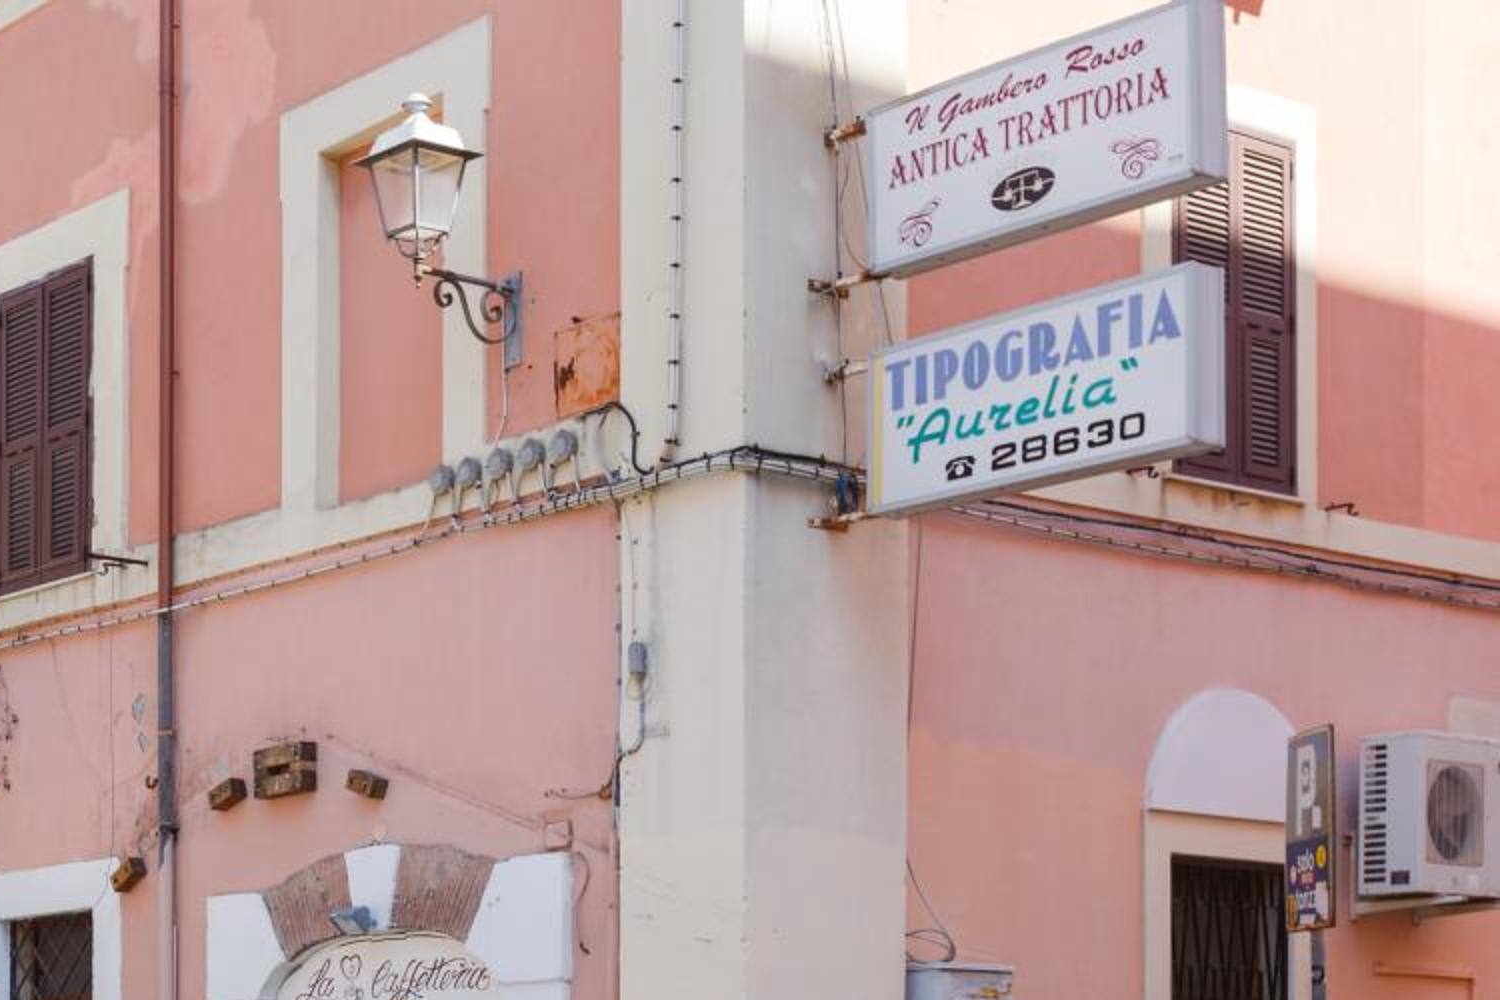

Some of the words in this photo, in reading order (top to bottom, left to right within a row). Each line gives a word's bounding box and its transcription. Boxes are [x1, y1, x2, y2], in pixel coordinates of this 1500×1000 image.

[888, 127, 991, 189] ANTICA
[998, 67, 1171, 151] TRATTORIA
[938, 74, 1049, 132] Gambero
[1065, 38, 1148, 79] Rosso
[885, 288, 1181, 411] TIPOGRAFIA
[991, 411, 1145, 471] 28630
